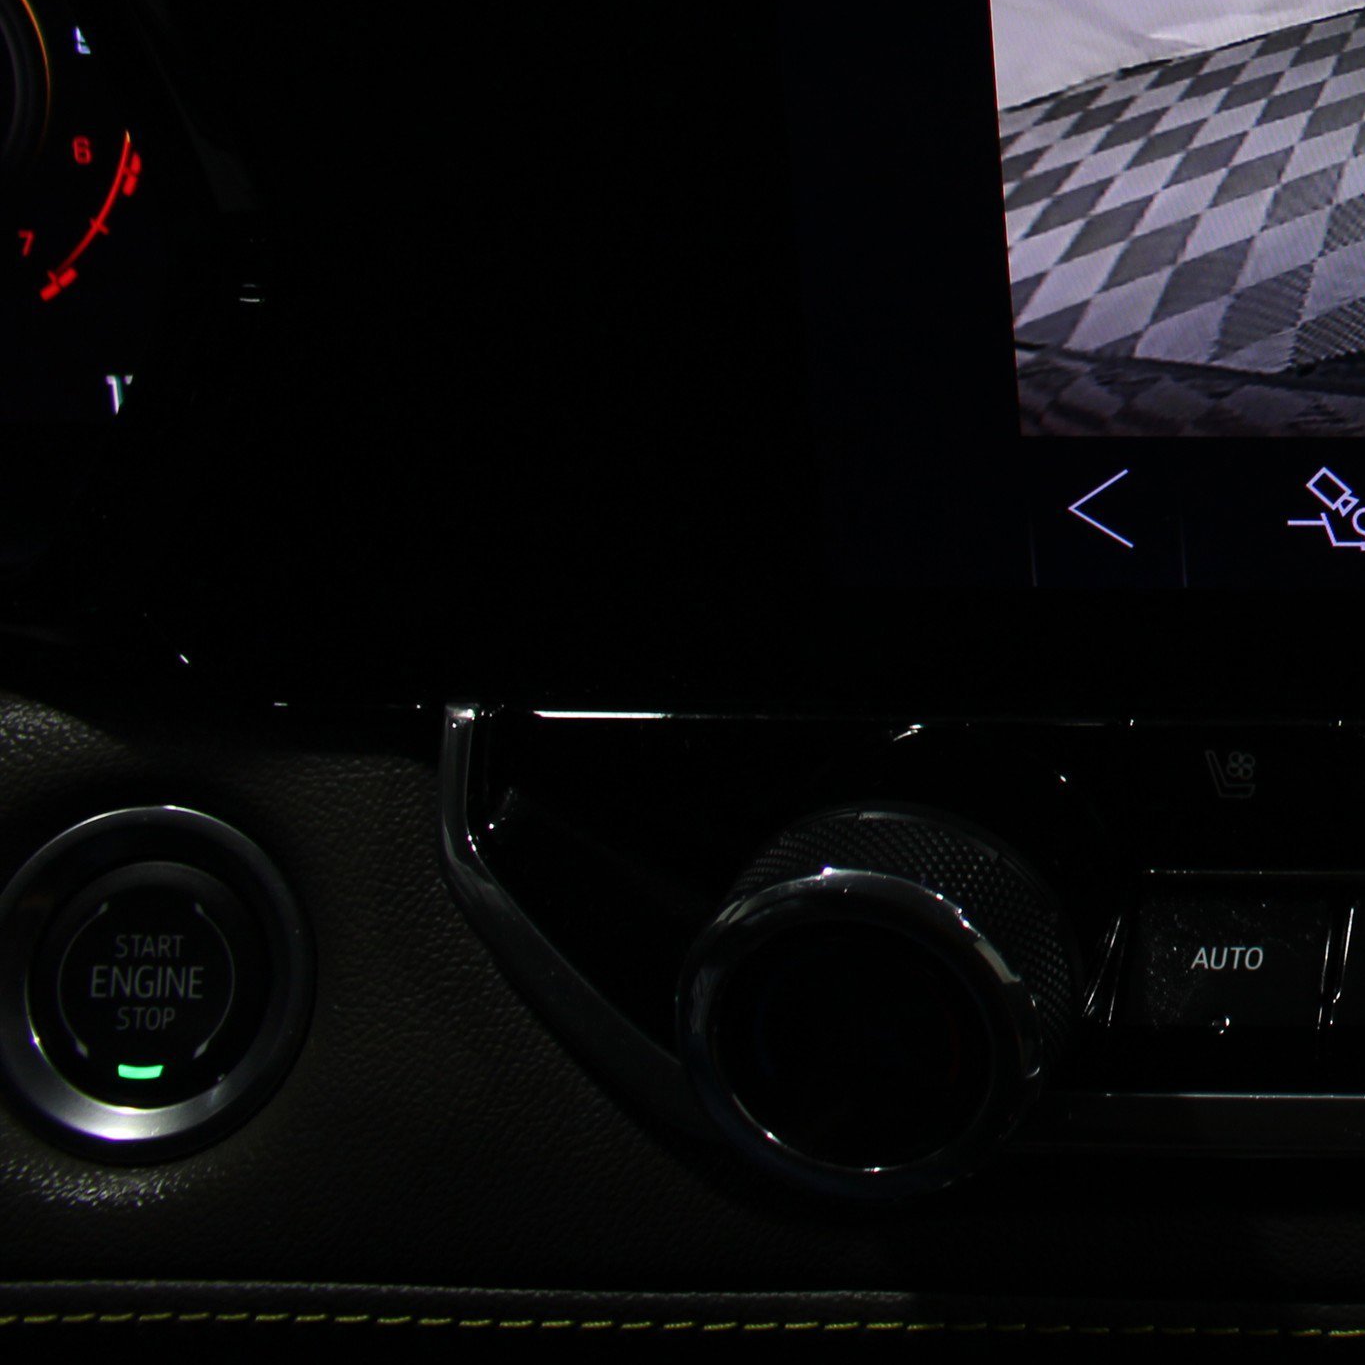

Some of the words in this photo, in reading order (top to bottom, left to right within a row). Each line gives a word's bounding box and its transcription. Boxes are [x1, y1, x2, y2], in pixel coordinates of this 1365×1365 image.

[72, 136, 92, 164] 6
[18, 230, 34, 256] 7
[116, 934, 184, 959] START
[1191, 946, 1264, 971] AUTO
[90, 965, 204, 999] ENGINE
[116, 1006, 176, 1031] STOP
